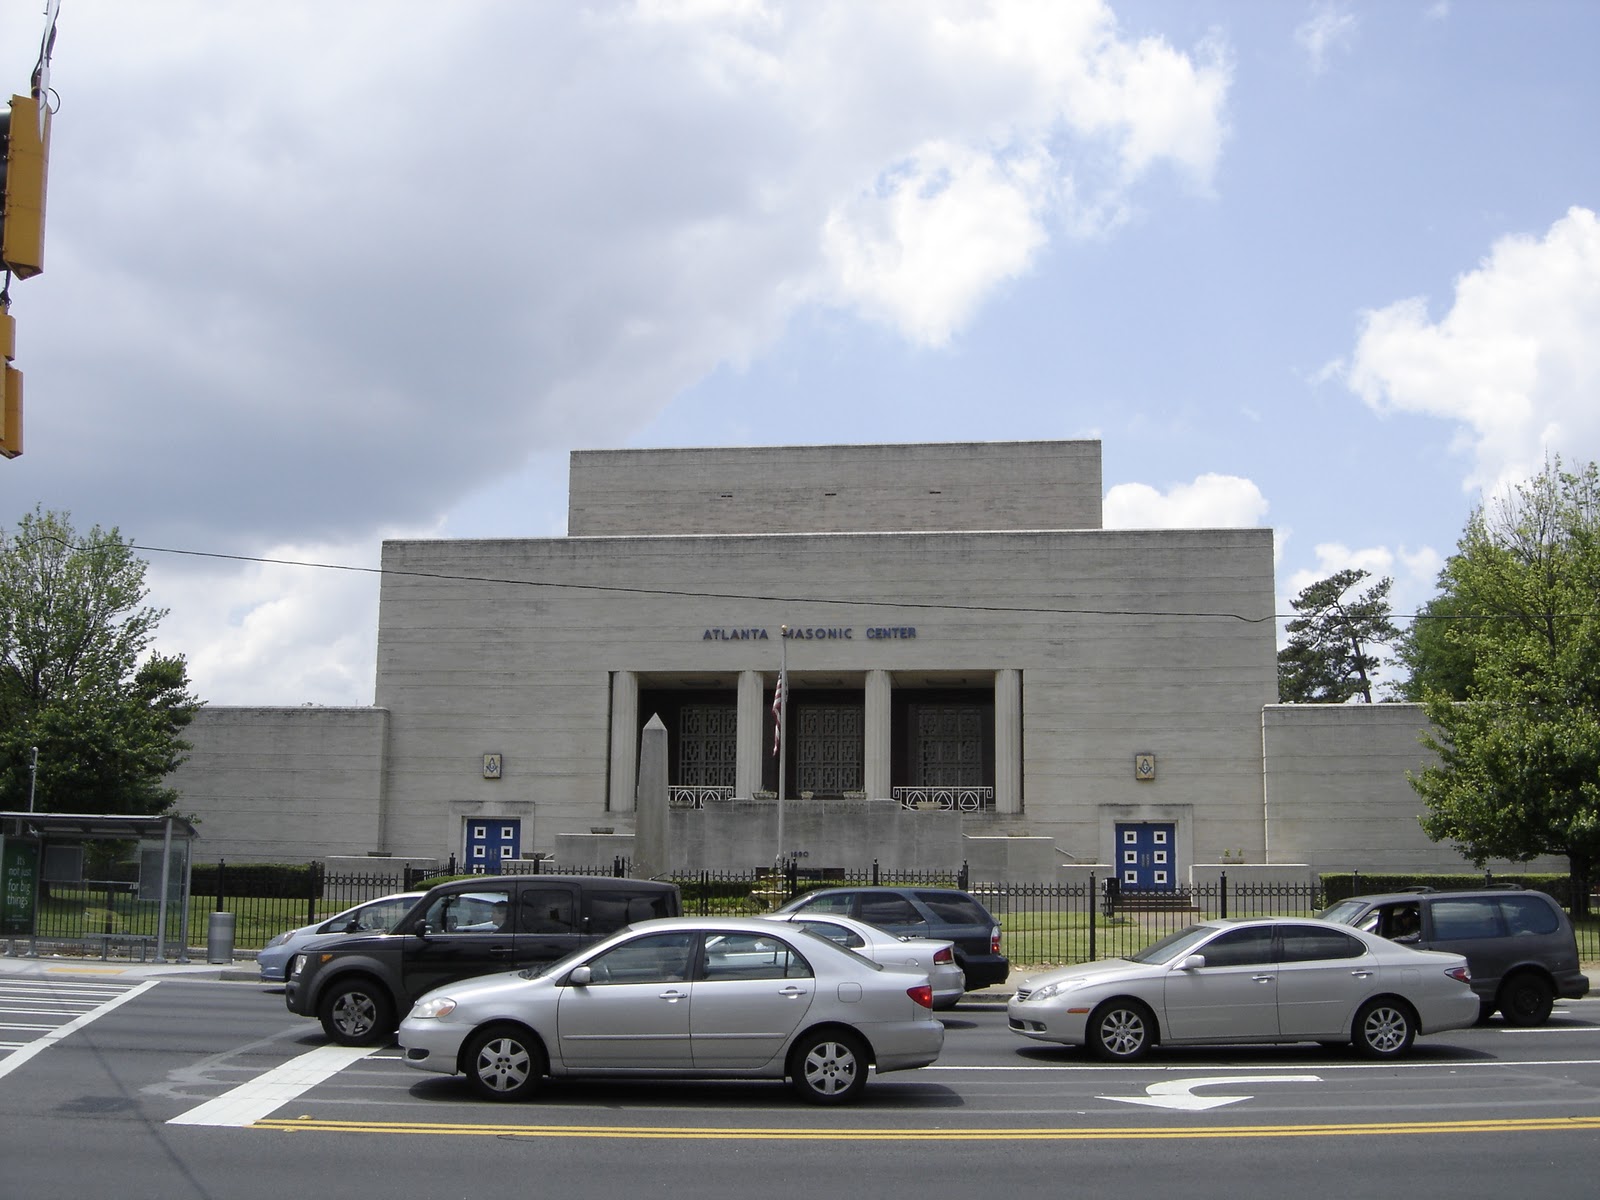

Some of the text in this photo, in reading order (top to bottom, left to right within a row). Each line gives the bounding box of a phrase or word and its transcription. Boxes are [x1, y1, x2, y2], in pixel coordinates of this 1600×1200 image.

[703, 627, 916, 640] ATLANTA MASONIC CENTER
[9, 867, 20, 876] not
[8, 878, 31, 895] for big
[7, 893, 28, 908] things
